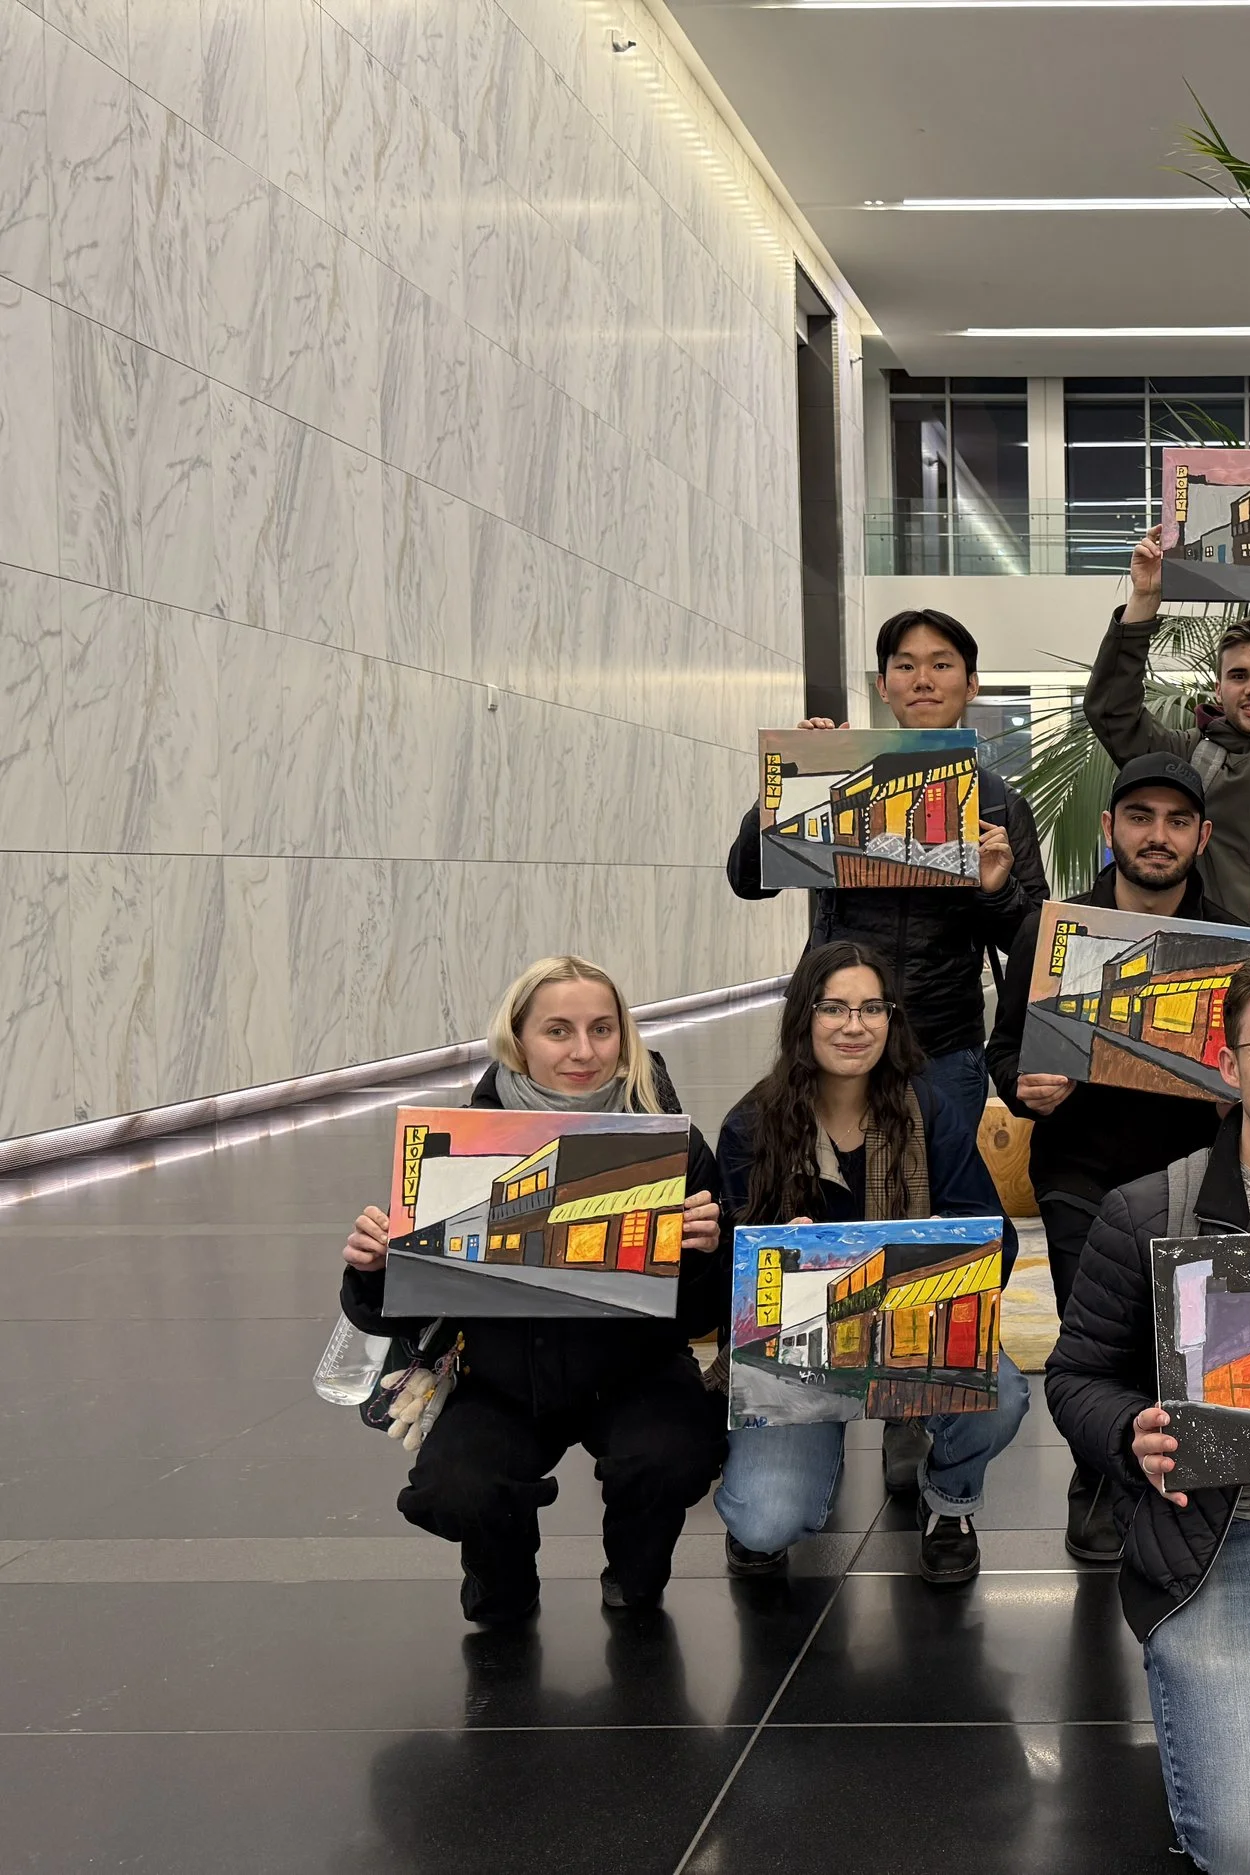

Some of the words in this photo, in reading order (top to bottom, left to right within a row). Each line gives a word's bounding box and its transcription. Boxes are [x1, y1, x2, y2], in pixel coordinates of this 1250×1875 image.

[1177, 467, 1186, 509] ROXY
[769, 755, 778, 795] ROXY
[408, 1128, 421, 1194] ROXY
[764, 1252, 773, 1323] ROXY
